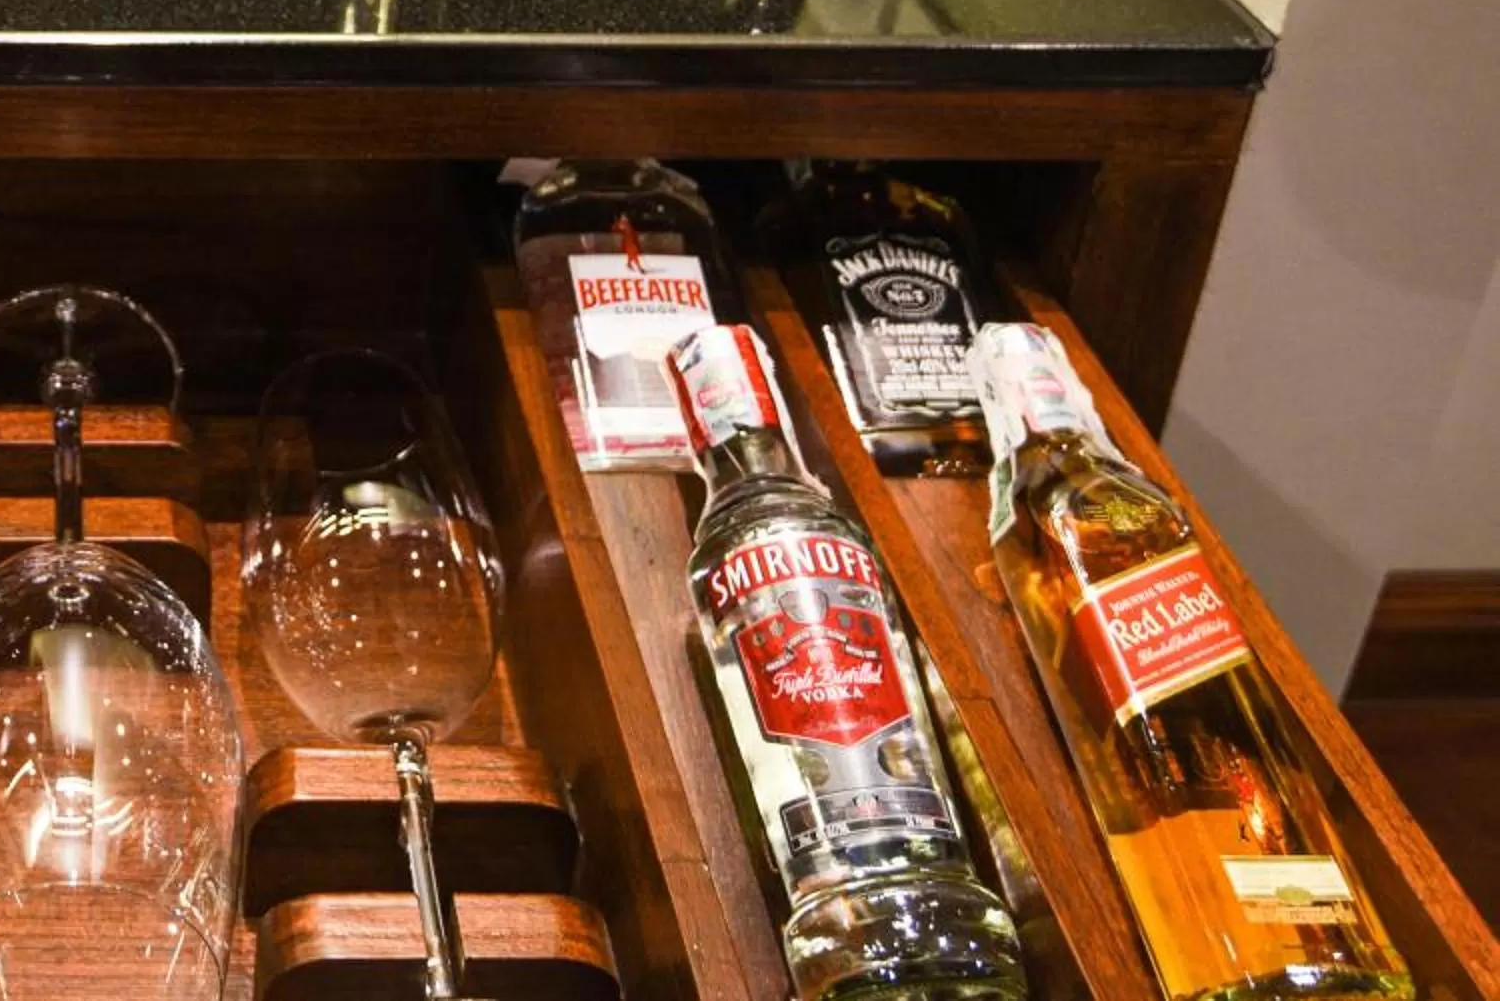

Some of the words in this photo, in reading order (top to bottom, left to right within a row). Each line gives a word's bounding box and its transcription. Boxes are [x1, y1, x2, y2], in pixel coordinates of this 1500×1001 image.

[578, 278, 708, 311] BEEFEATER
[711, 541, 873, 608] SMIRNOFF
[1107, 607, 1165, 652] Red
[1156, 582, 1224, 630] Label
[801, 686, 865, 705] VODKA
